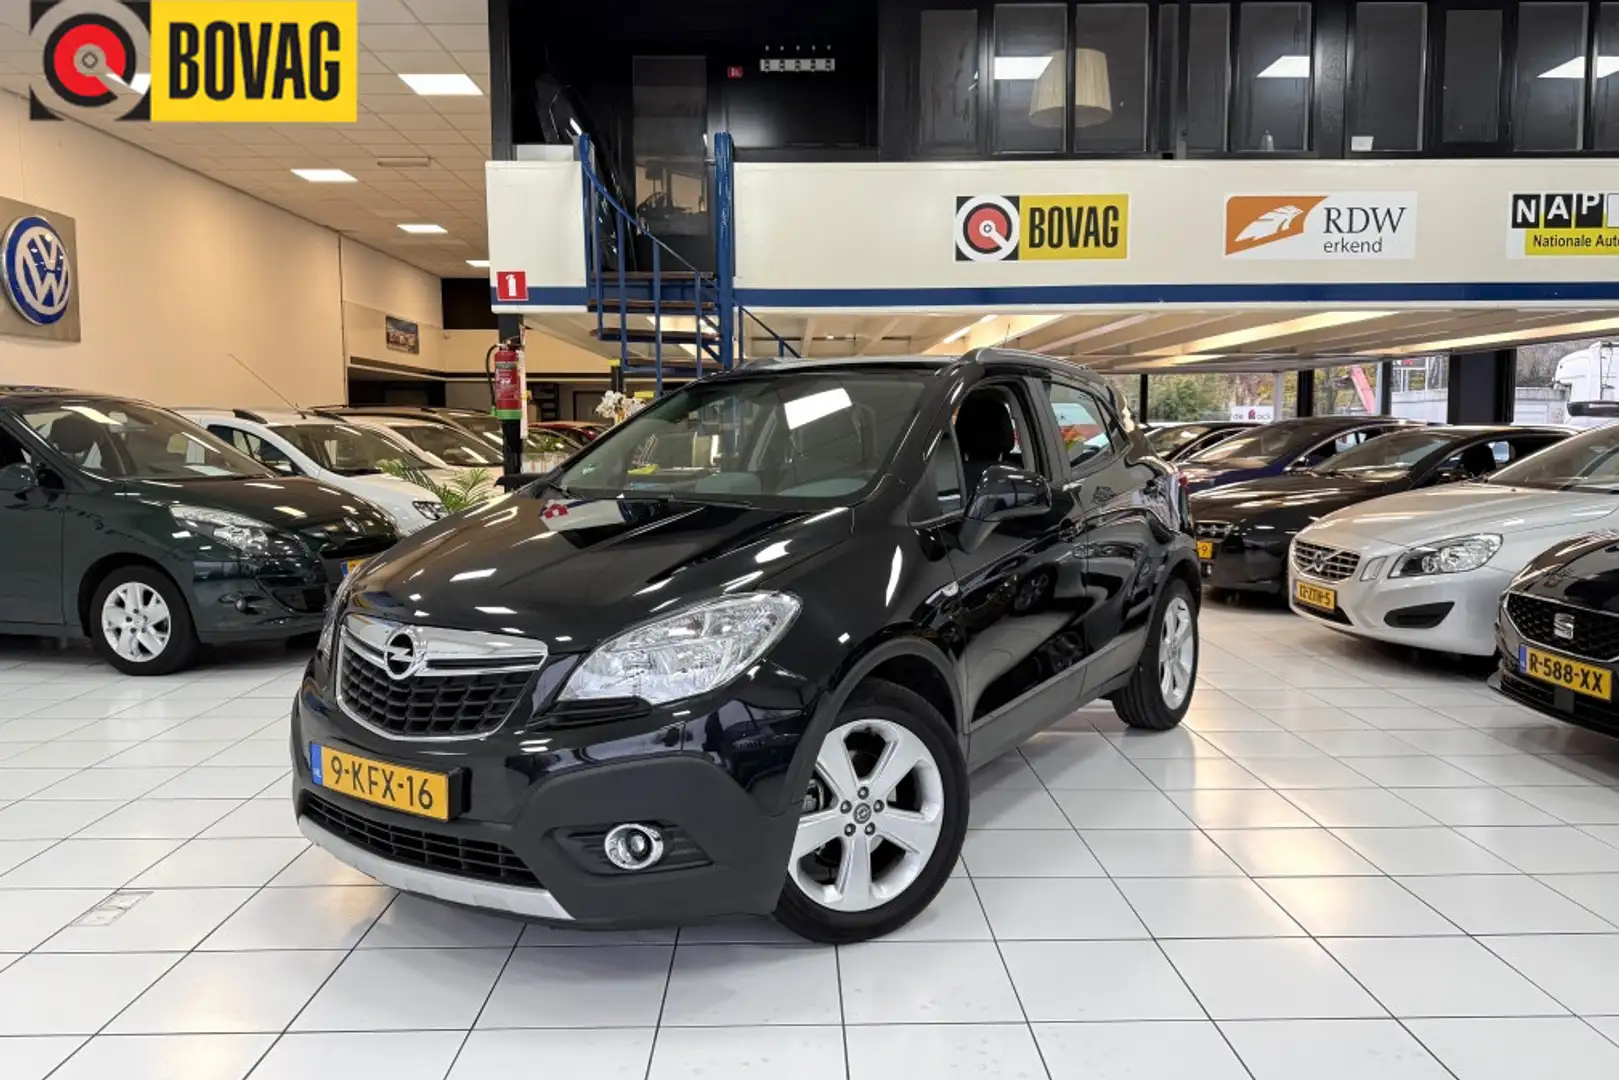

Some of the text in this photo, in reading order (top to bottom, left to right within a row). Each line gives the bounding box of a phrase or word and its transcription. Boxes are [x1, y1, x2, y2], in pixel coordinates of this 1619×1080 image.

[1028, 205, 1120, 249] BOVAG
[1322, 206, 1407, 234] RDW
[1323, 236, 1383, 253] erkend
[1532, 234, 1619, 248] Nationale Aut
[1529, 653, 1604, 694] R-588-XX
[330, 755, 434, 810] 9-KFX-16
